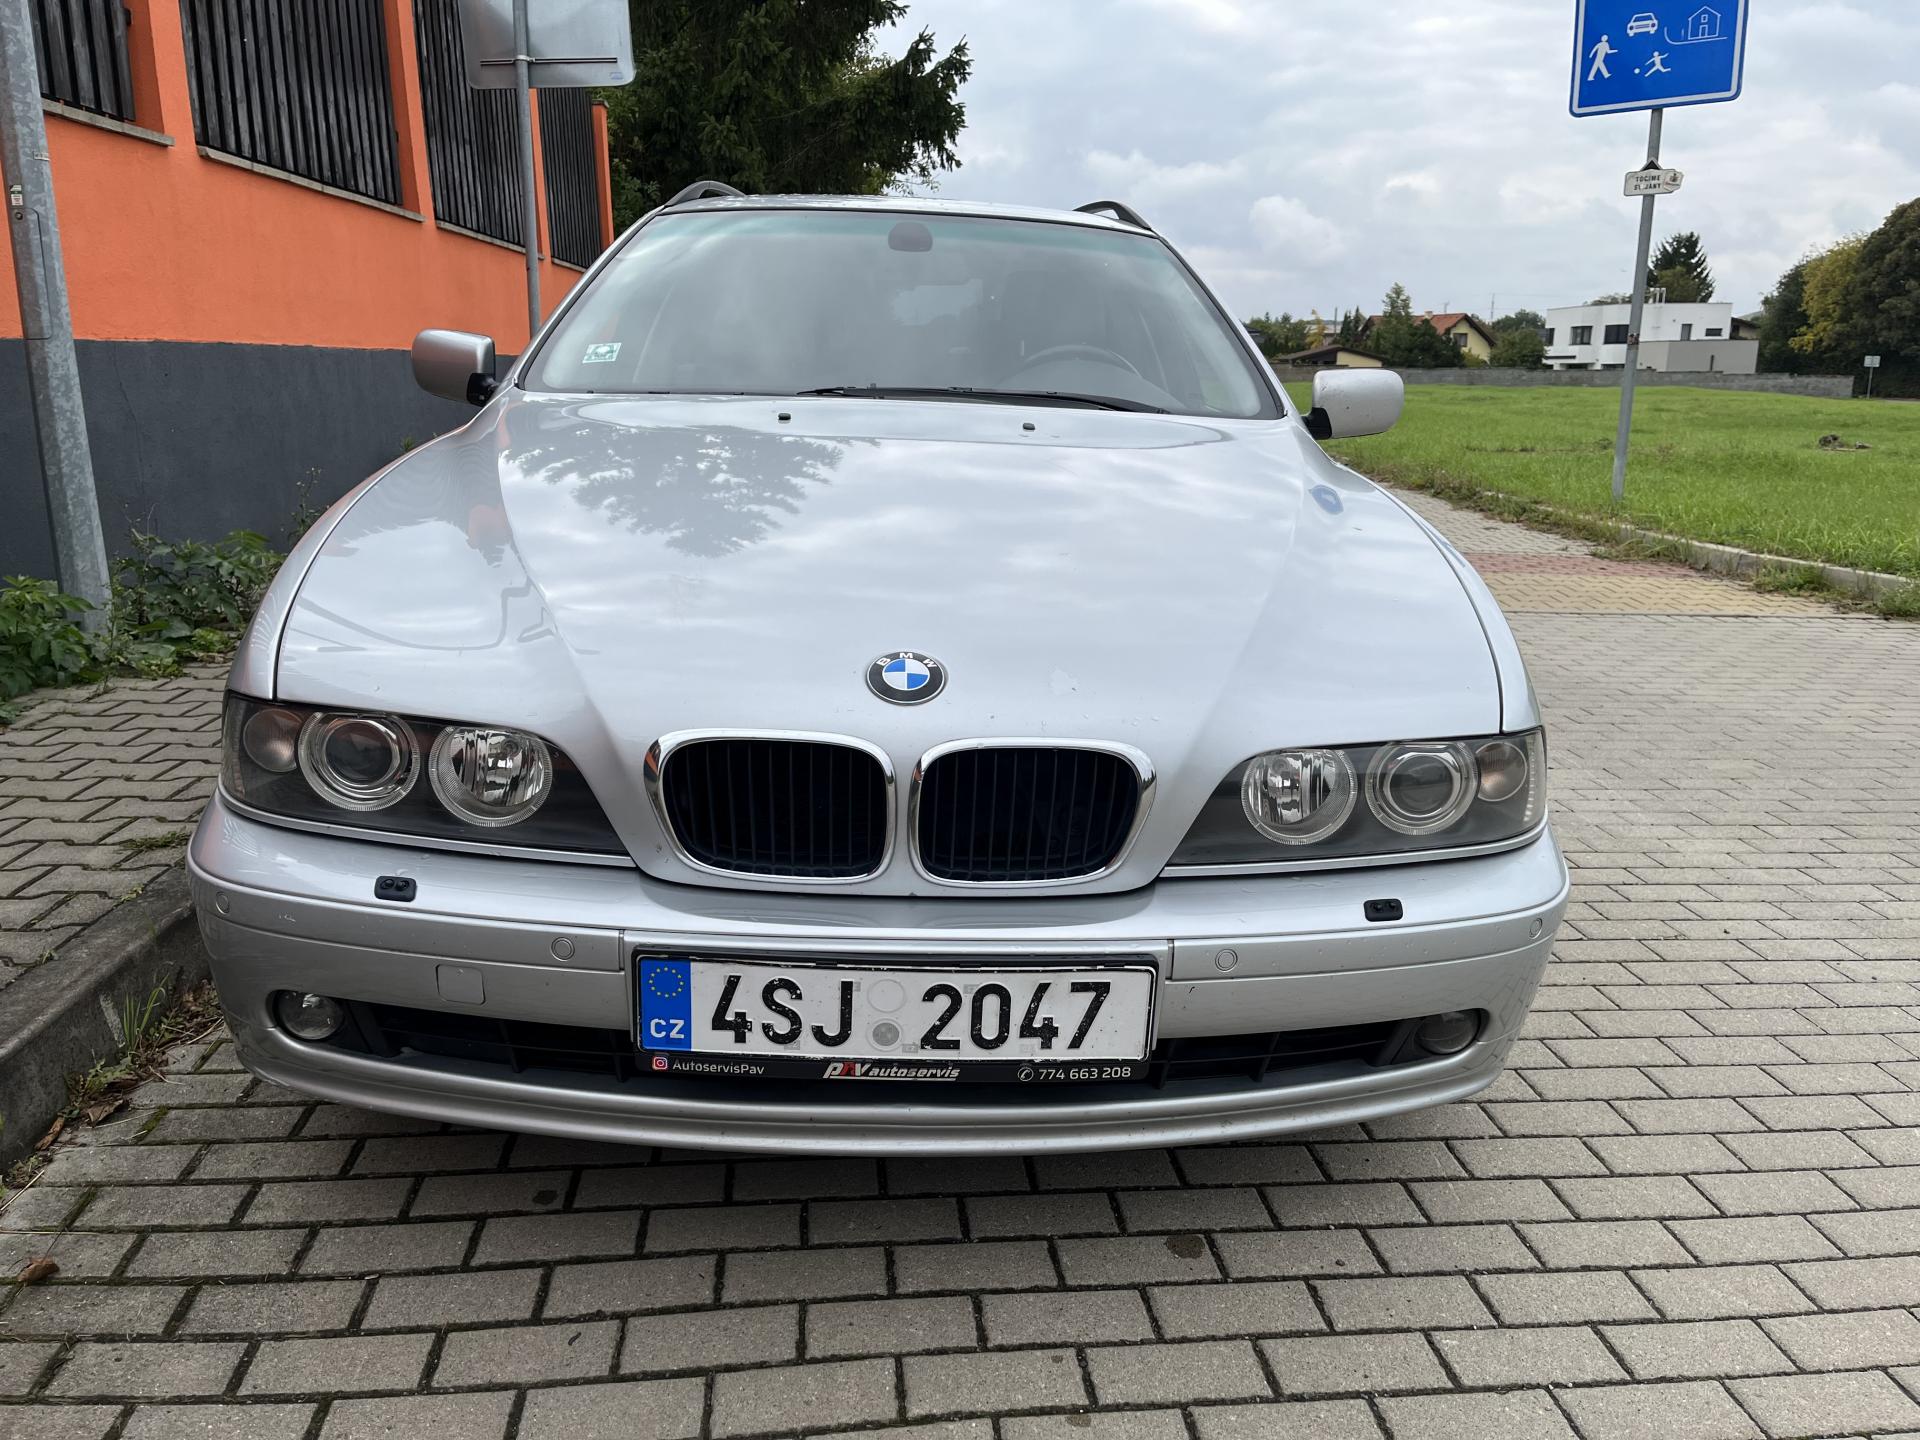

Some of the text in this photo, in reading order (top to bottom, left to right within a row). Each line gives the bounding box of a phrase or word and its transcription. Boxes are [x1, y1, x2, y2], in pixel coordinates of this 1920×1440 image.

[876, 652, 937, 668] BMW
[711, 974, 1111, 1050] 4SJ 2047
[649, 1018, 685, 1039] CZ
[672, 1060, 765, 1075] AutoservisPav
[1039, 1067, 1131, 1080] 774 663 208
